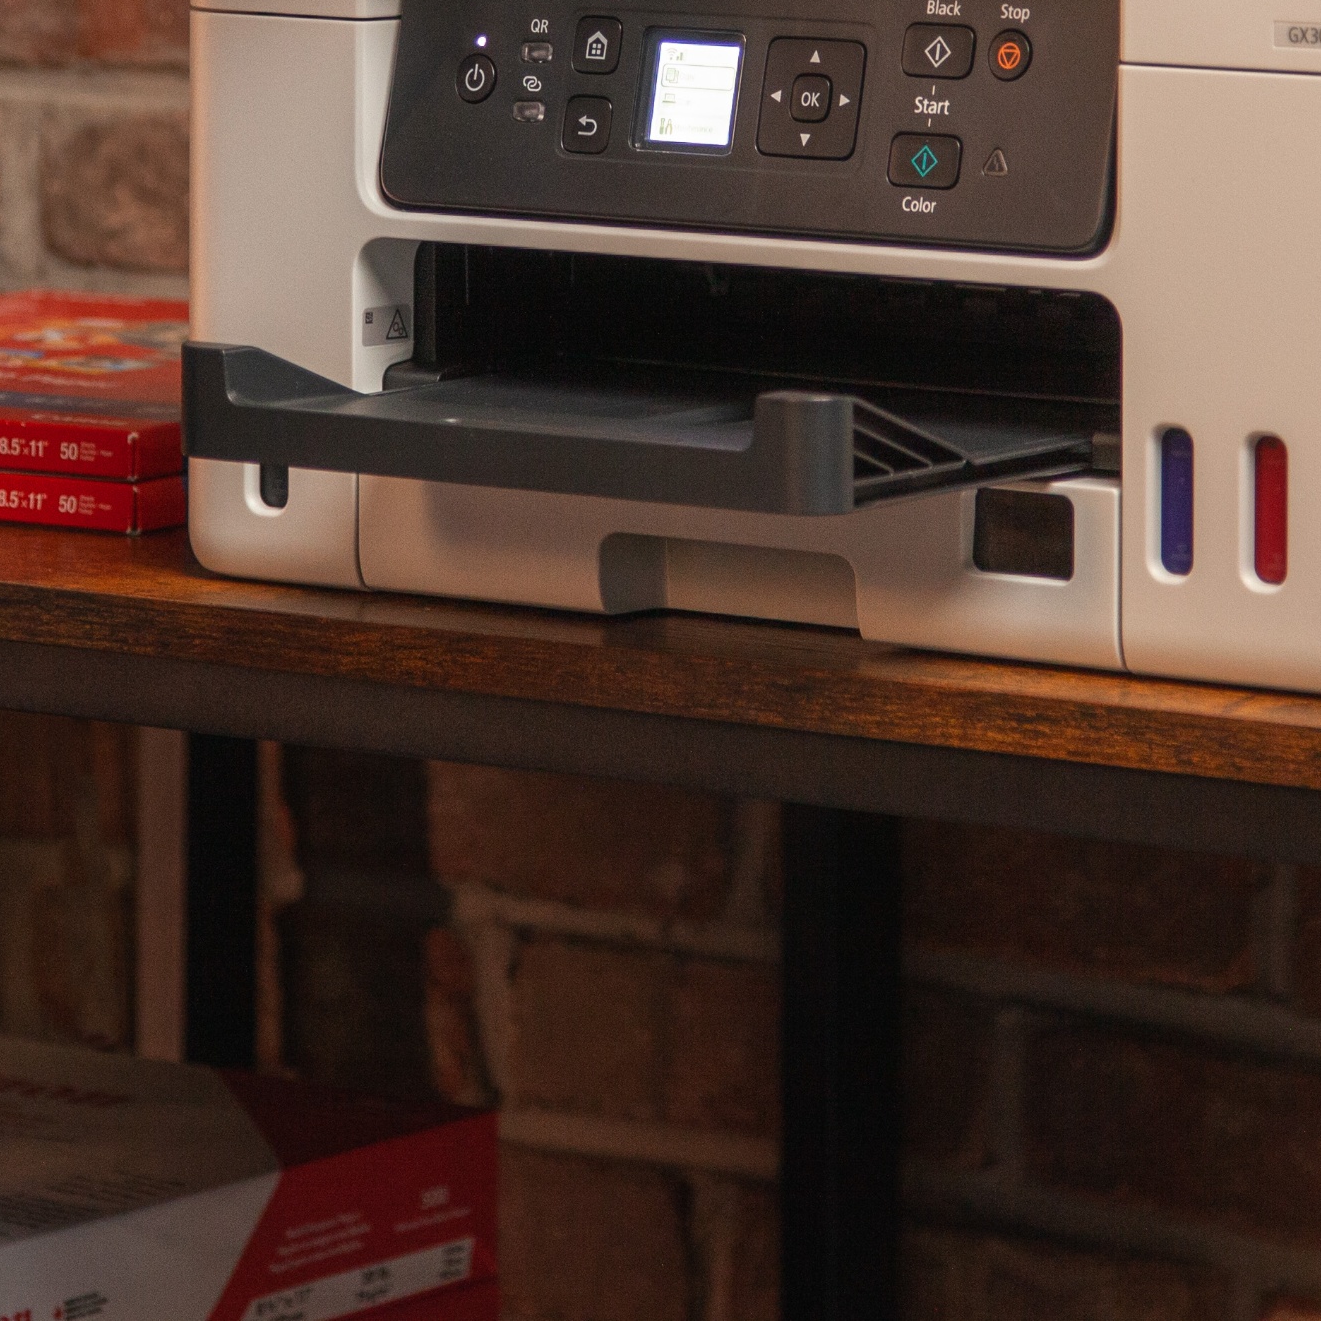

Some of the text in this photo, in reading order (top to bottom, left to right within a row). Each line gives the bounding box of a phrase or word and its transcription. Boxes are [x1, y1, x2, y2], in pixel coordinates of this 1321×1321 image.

[926, 0, 962, 16] Black
[1000, 3, 1030, 23] Stop
[530, 19, 549, 34] QR
[801, 91, 820, 108] OK
[914, 97, 950, 115] Start
[902, 196, 937, 214] Color
[60, 442, 78, 461] 50
[58, 494, 77, 514] 50
